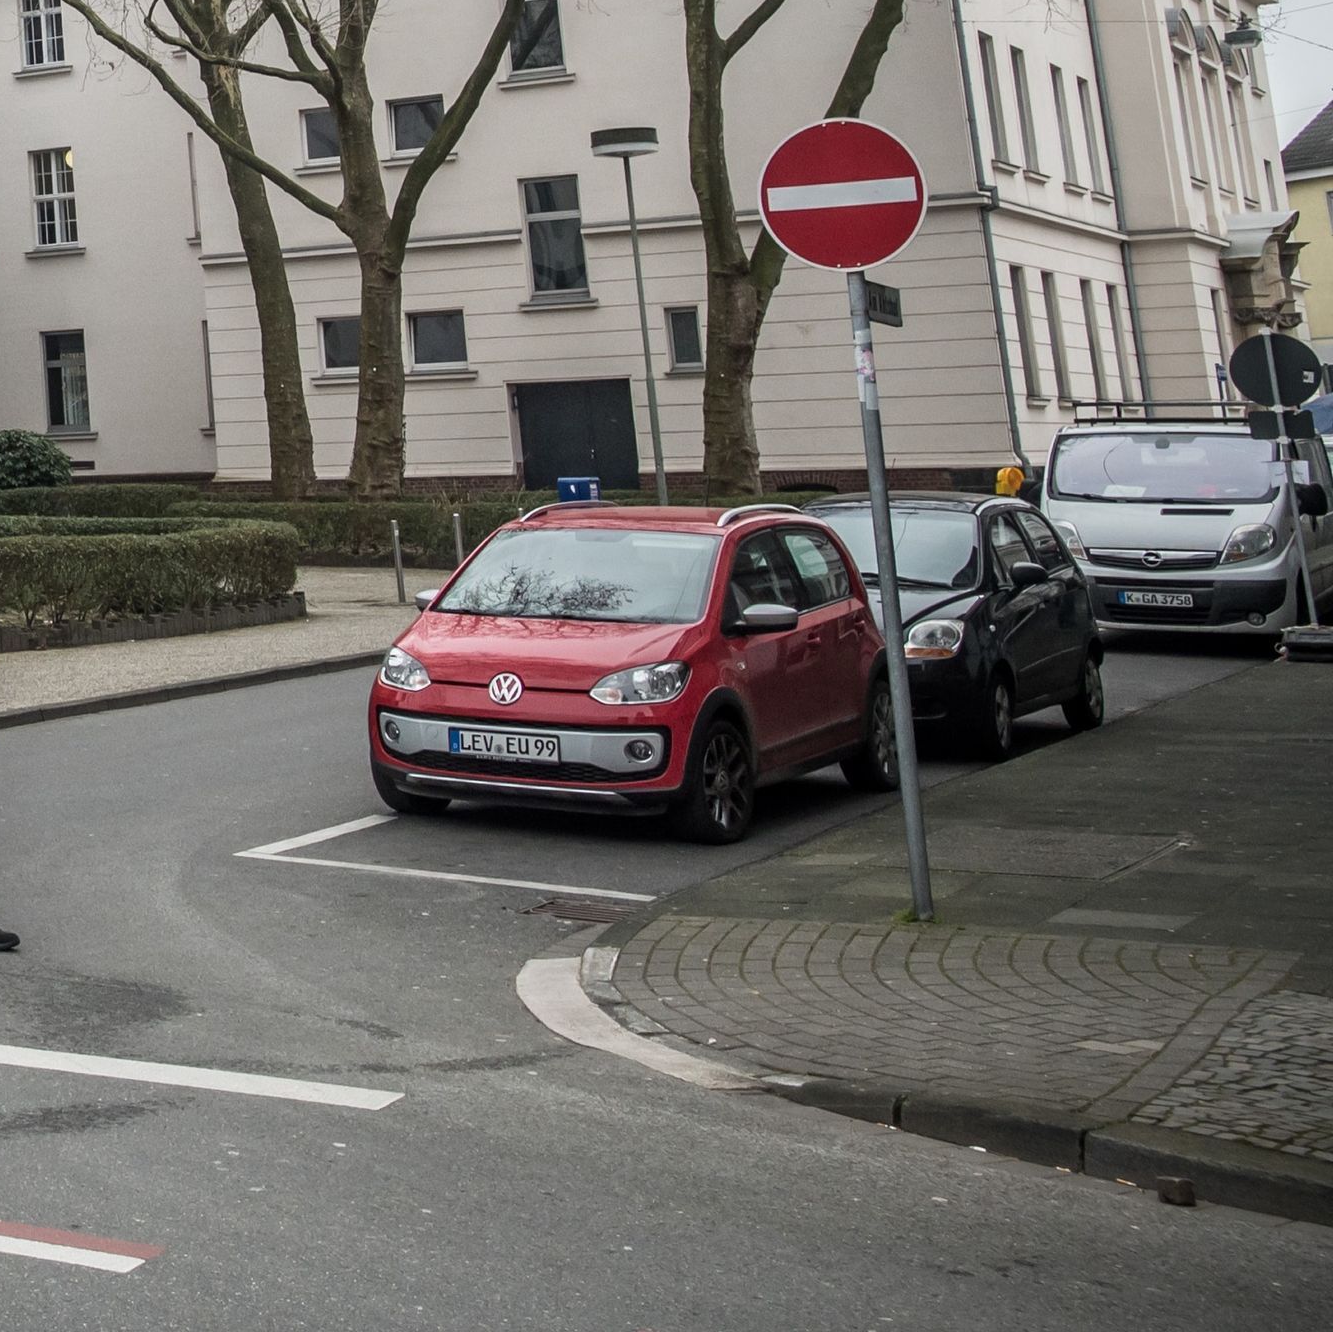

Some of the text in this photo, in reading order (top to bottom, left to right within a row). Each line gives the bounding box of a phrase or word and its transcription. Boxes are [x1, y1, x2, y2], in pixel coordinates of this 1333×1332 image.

[1125, 593, 1192, 606] K GA 3758
[460, 733, 493, 752] LEV
[506, 737, 530, 755] EU
[534, 739, 556, 758] 99
